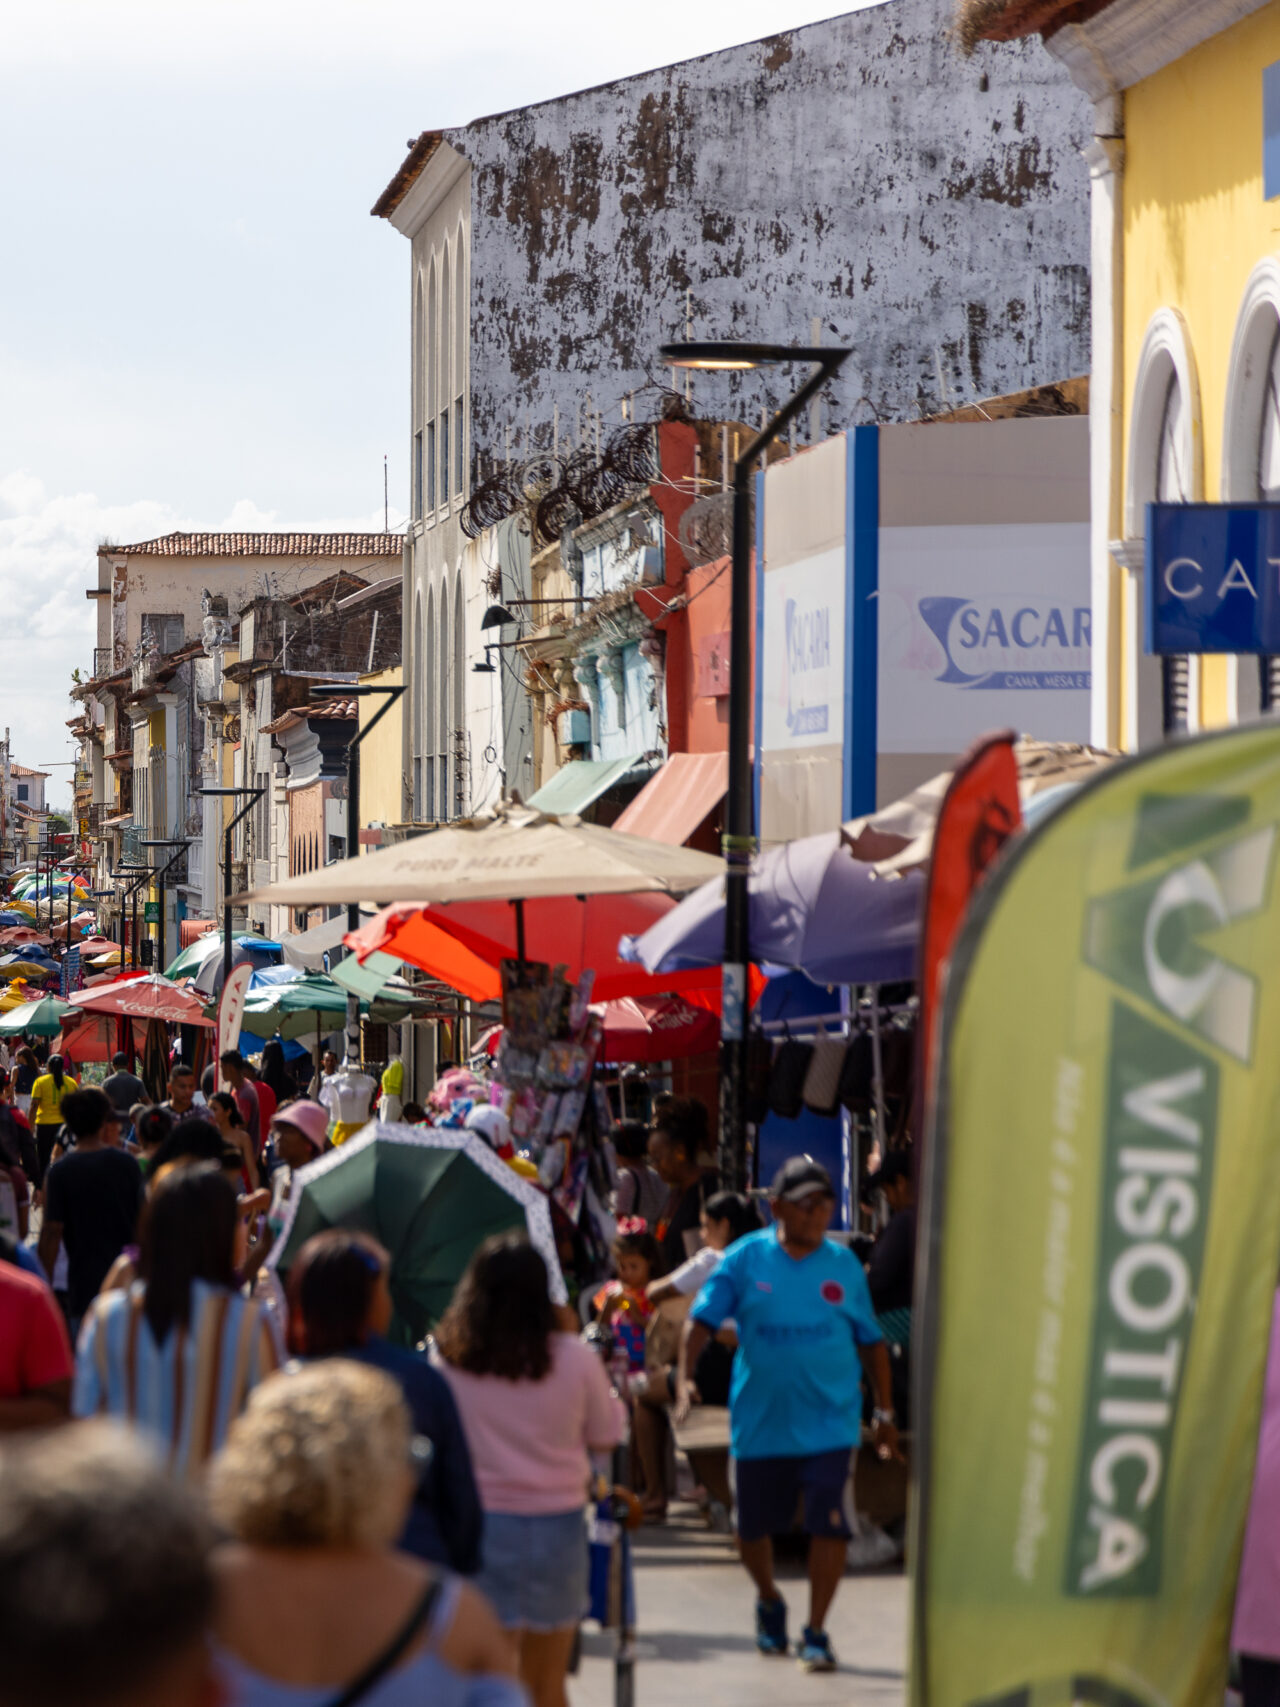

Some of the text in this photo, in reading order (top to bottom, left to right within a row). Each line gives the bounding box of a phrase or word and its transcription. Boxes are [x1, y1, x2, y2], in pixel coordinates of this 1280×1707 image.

[960, 607, 1092, 648] SACAR
[463, 853, 545, 870] MALTE
[1079, 1066, 1206, 1592] VISÓTICA
